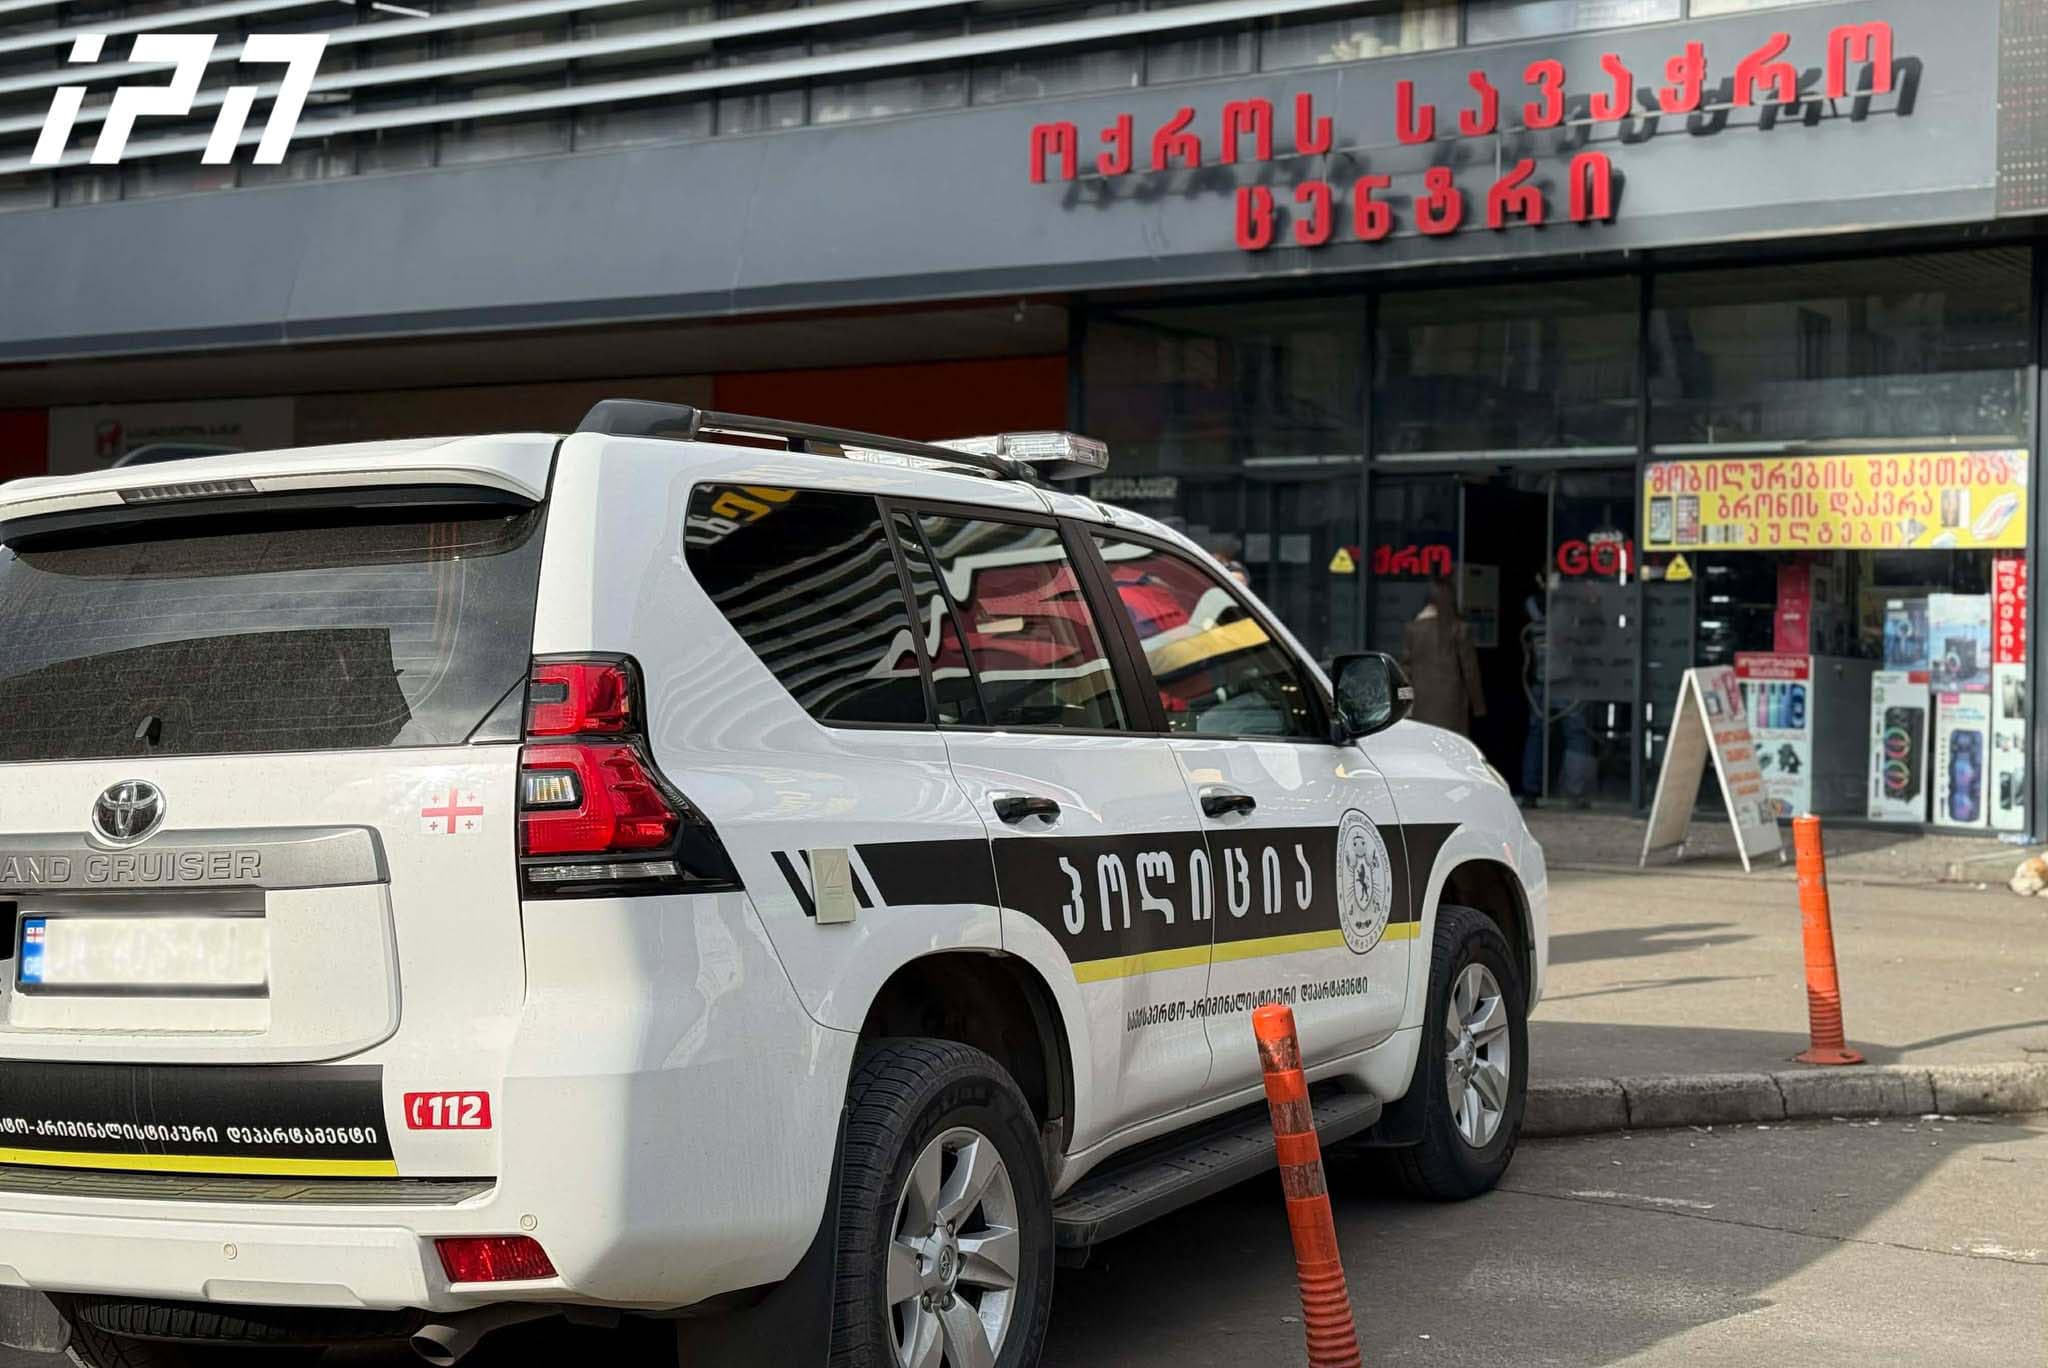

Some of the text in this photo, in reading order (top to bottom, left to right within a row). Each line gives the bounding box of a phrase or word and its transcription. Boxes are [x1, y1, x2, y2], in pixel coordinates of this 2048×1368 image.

[1030, 21, 1893, 184] ოქროს სავაჭრო
[1235, 152, 1611, 250] ცენტრი
[1652, 456, 2011, 492] მობილურების შეკეთება
[1718, 492, 1818, 519] ბრონის
[84, 850, 262, 884] CRUISER
[1058, 843, 1313, 935] პოლიცია
[1300, 976, 1369, 1003] დეპარტამენტი
[428, 1095, 482, 1126] 112
[227, 1127, 377, 1144] დეპარტამენტი
